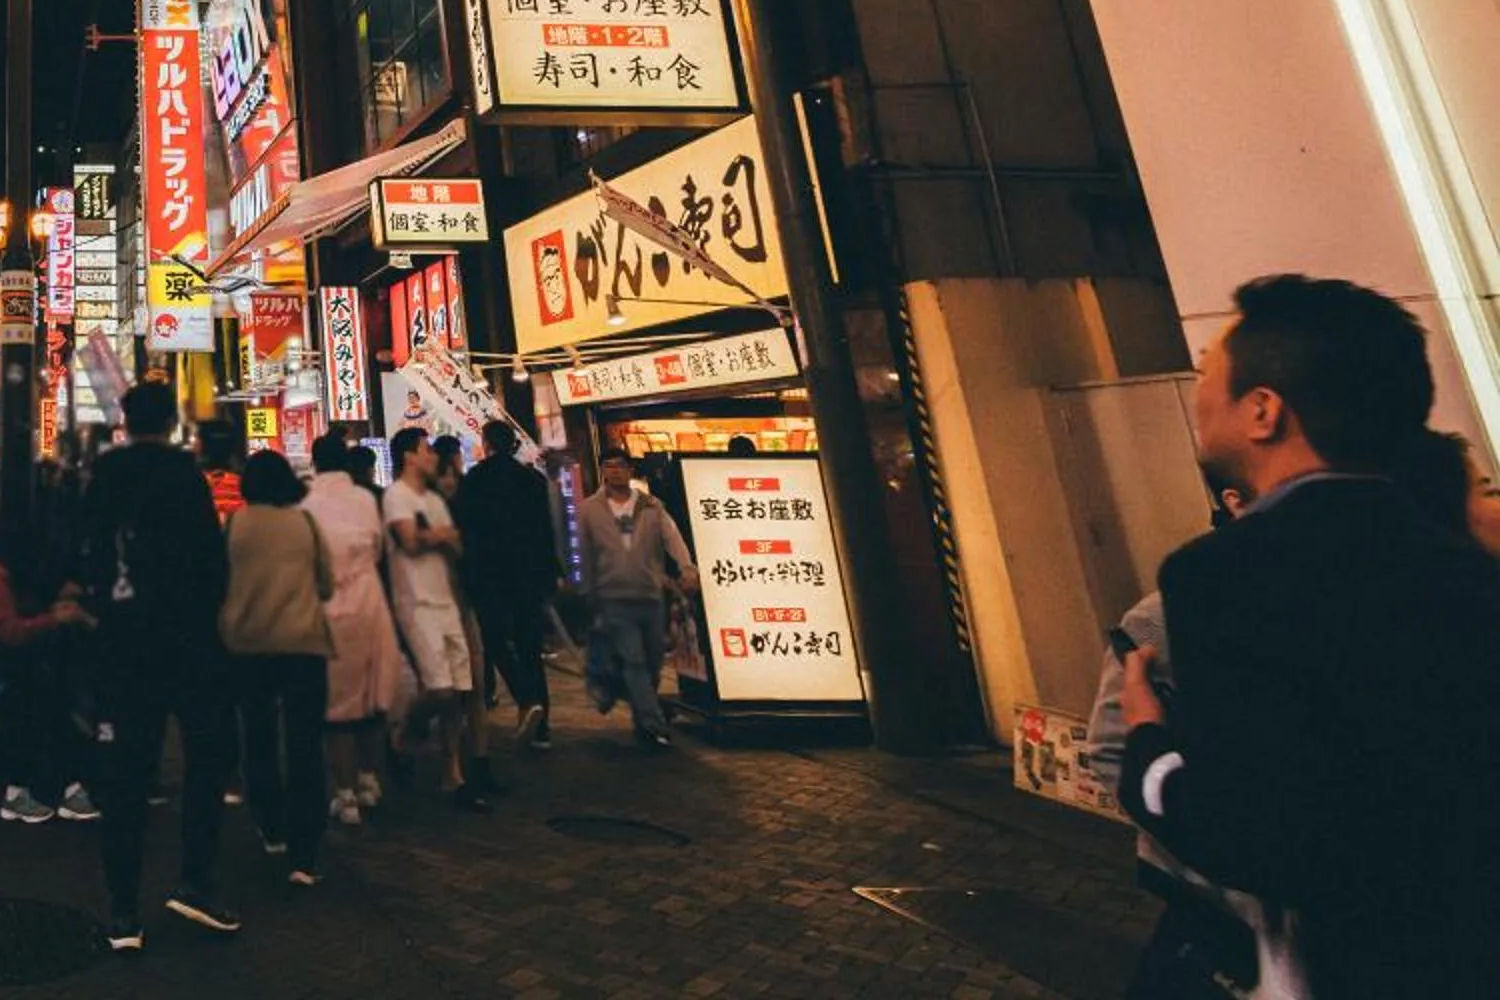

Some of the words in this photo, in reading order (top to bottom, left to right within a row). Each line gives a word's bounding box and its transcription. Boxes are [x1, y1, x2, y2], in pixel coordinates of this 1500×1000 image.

[533, 51, 702, 90] 寿司・和食
[157, 36, 194, 231] ツルハドラッグ
[410, 184, 450, 200] 地階
[389, 211, 480, 233] 個室・和食
[165, 272, 194, 302] 薬
[255, 297, 301, 313] ツルハ
[330, 296, 361, 411] 大阪みやげ
[744, 480, 763, 489] 4F
[700, 500, 815, 521] 宴会お座敷
[755, 542, 773, 552] 3F
